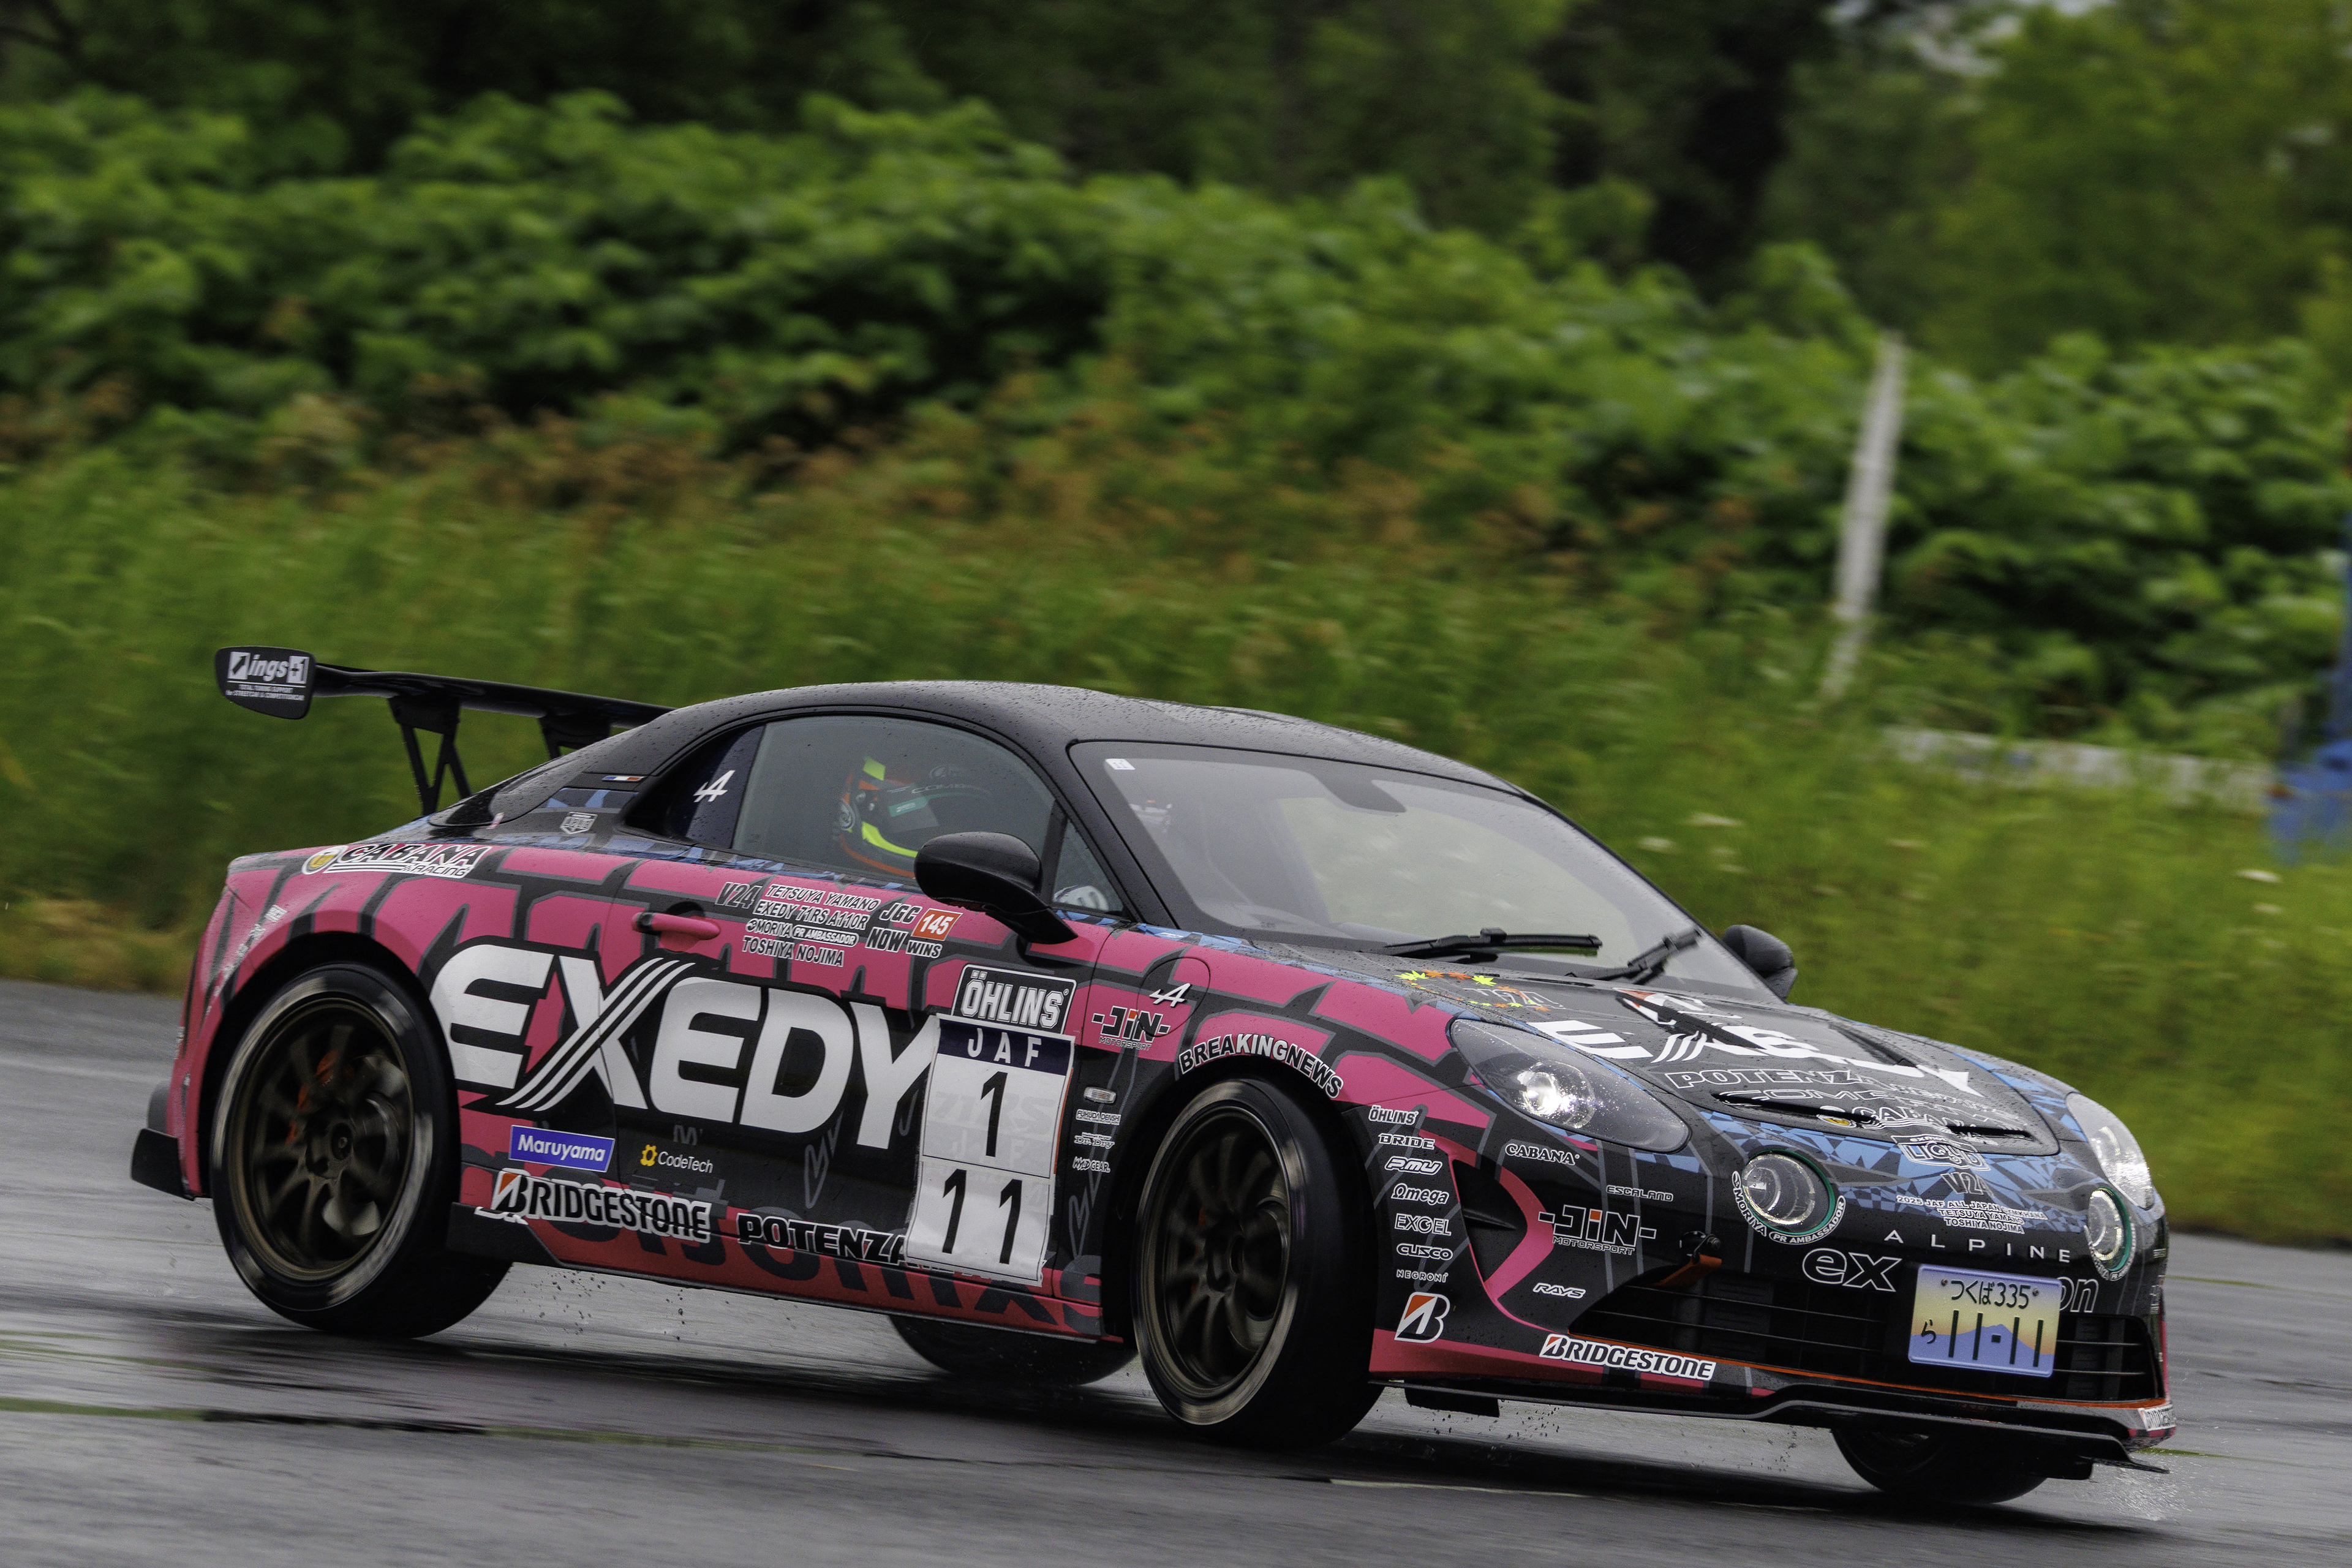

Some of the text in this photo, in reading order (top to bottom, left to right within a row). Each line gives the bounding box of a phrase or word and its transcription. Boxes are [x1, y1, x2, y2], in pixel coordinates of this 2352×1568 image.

[337, 844, 492, 867] CABANA
[413, 864, 470, 876] RACING
[715, 882, 762, 909] V24
[765, 883, 881, 913] TETSUYA YAMANO
[753, 899, 870, 930] EXEDY 71RS A110R
[880, 902, 922, 924] JGC
[921, 913, 954, 936] 145
[756, 921, 856, 945] MORIYA PR AMBASSADOR
[865, 926, 909, 952] NOW
[742, 935, 845, 968] TOSHIYA NOJIMA
[905, 940, 943, 959] WINS
[960, 970, 1064, 1029] ÖHLINS
[430, 944, 933, 1150] EXEDY
[1098, 1036, 1152, 1051] MOTORSPORT
[981, 1071, 1008, 1158] 1
[518, 1134, 606, 1162] Maruyama
[1074, 1135, 1092, 1145] Dr.
[1093, 1139, 1115, 1149] Dry
[1379, 1133, 1435, 1150] BRIDE
[658, 1152, 714, 1174] CodeTech
[1606, 1185, 1674, 1202] ESCALAND
[1896, 1195, 1924, 1206] 2025
[1924, 1199, 1945, 1208] JAF
[1947, 1200, 1970, 1209] ALL
[1970, 1201, 2001, 1213] JAPAN
[492, 1169, 711, 1242] BRIDGESTONE
[943, 1168, 1022, 1265] 11
[1733, 1187, 1845, 1244] MORIYA PR AMBASSADOR
[1937, 1208, 2025, 1225] TETSUYA YAMANO
[1943, 1217, 2025, 1234] TOSHIYA NOJIMA
[1396, 1243, 1453, 1260] CUSCO
[1551, 1236, 1635, 1256] MOTORSPORT
[1396, 1269, 1448, 1283] NEGRONI
[1532, 1283, 1586, 1299] RAYS
[1921, 1319, 1937, 1344] ら
[1539, 1333, 1717, 1381] BRIDGESTONE
